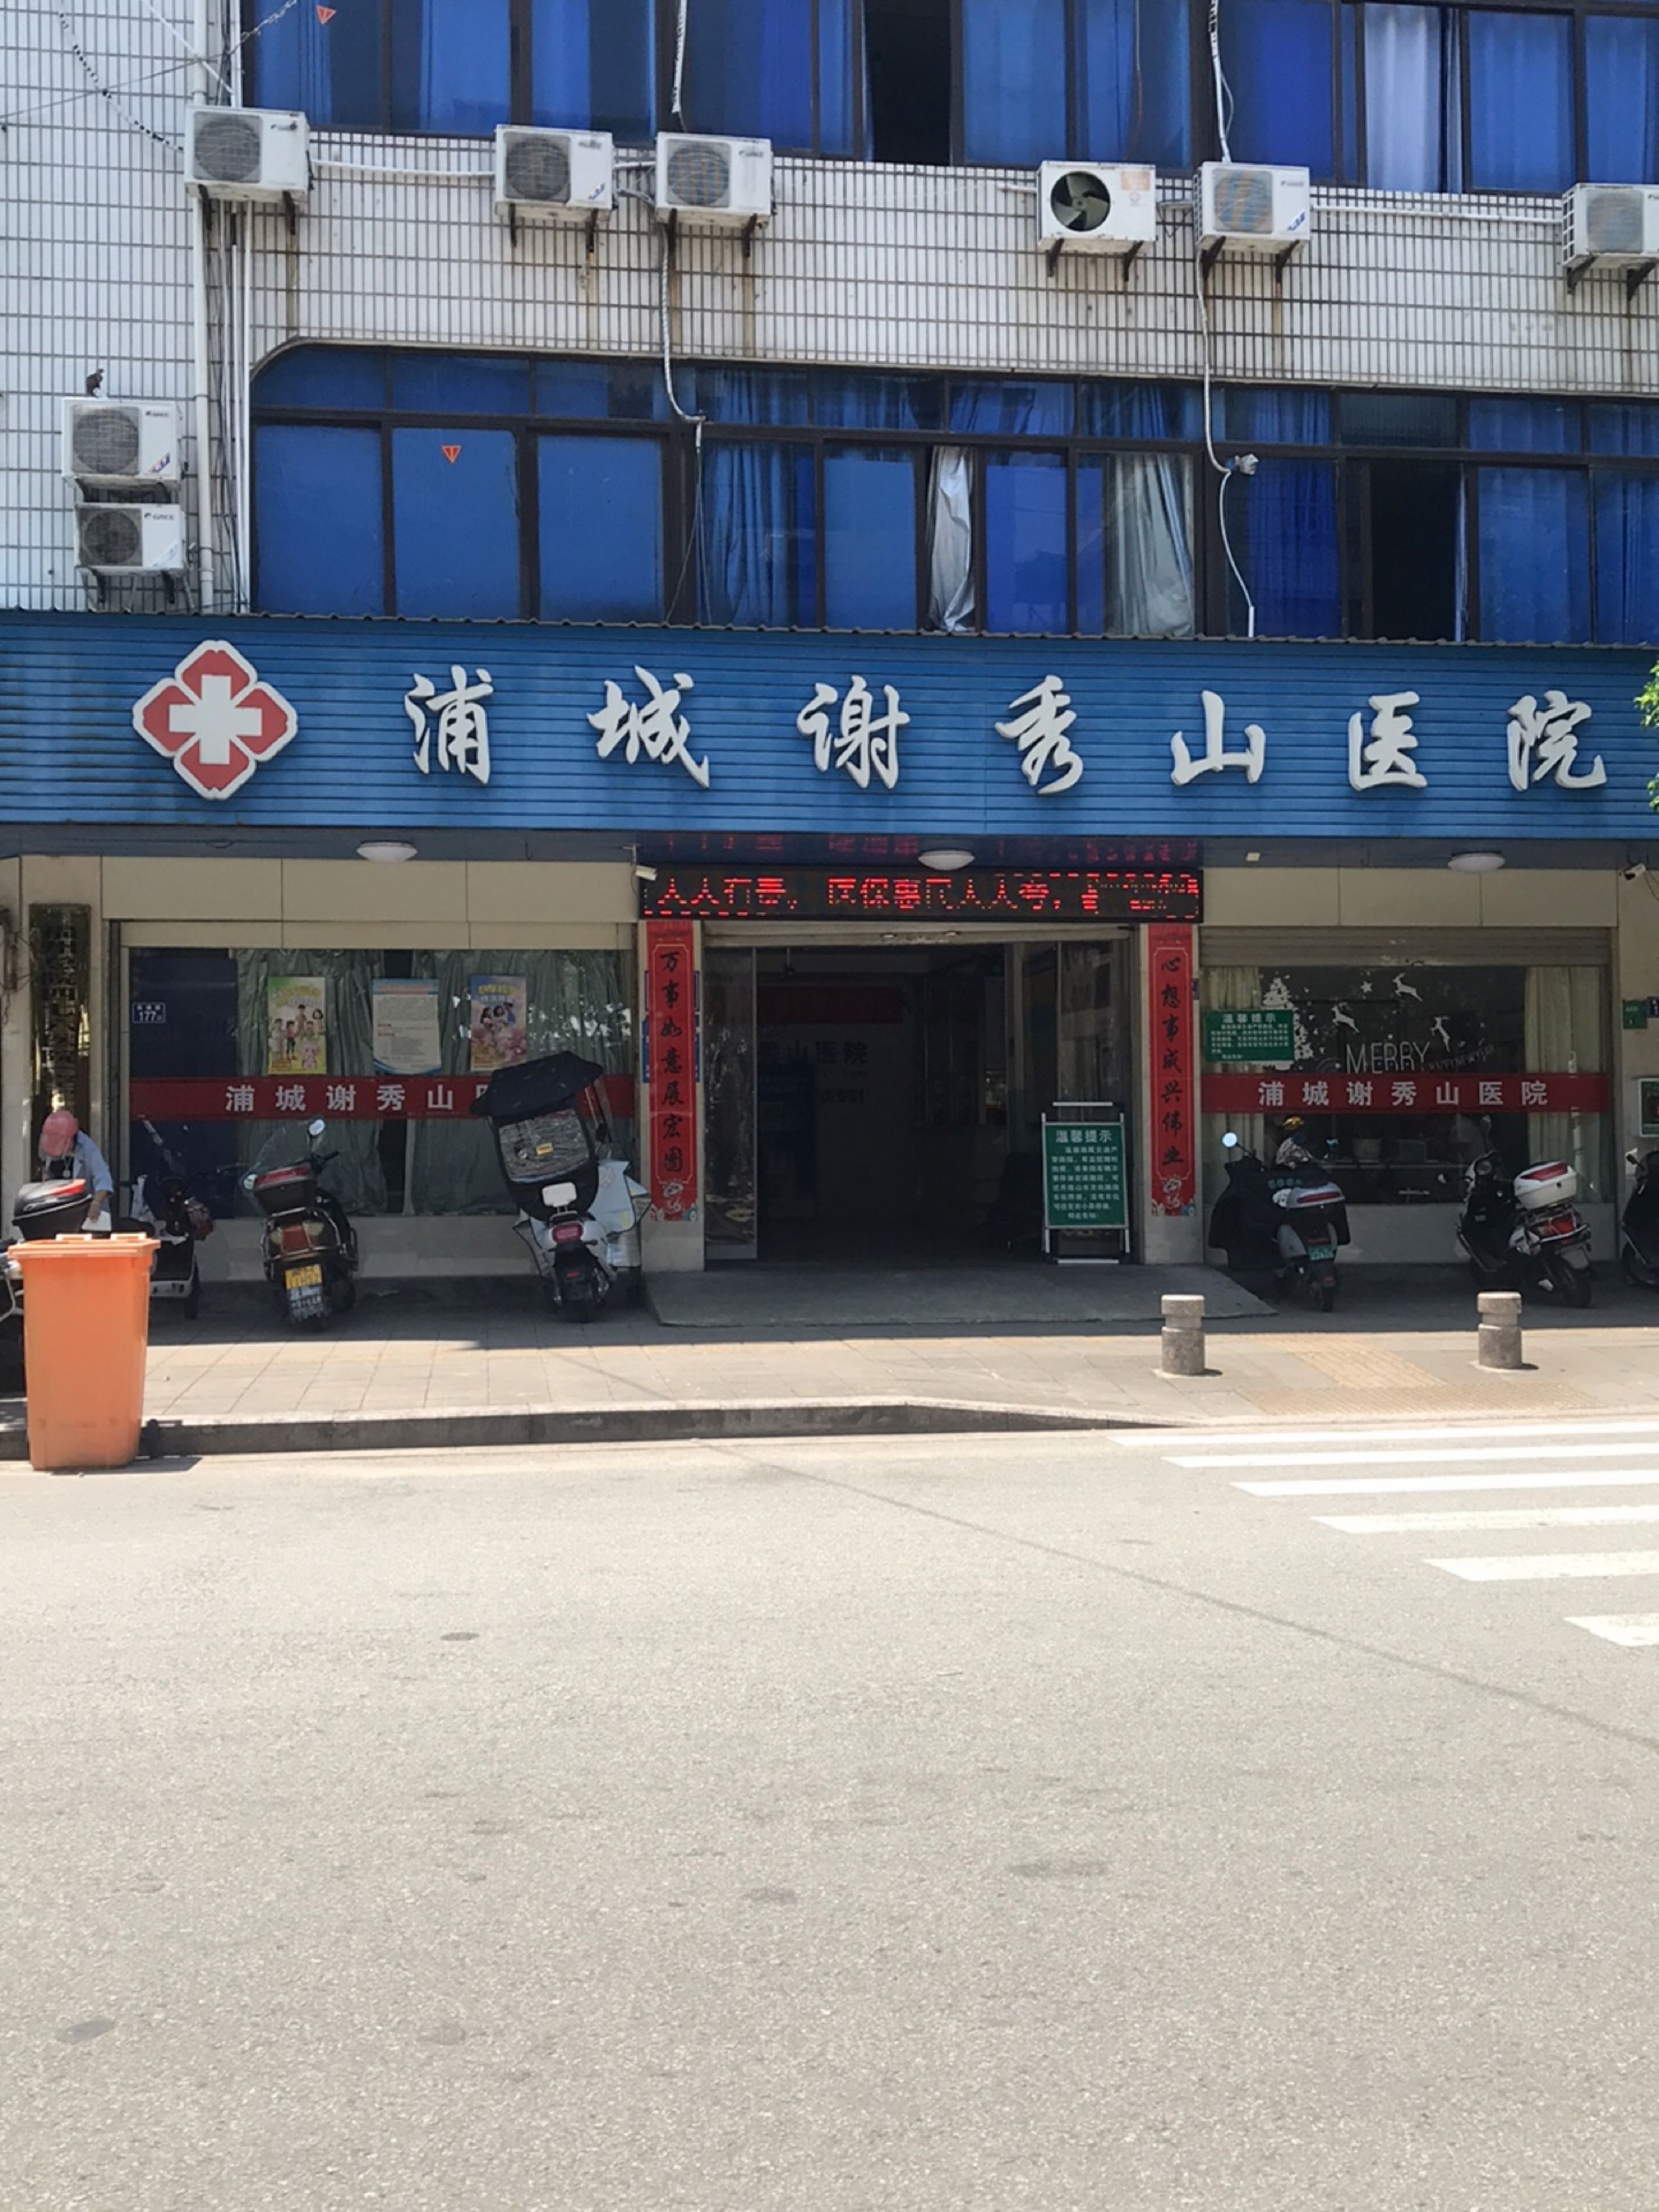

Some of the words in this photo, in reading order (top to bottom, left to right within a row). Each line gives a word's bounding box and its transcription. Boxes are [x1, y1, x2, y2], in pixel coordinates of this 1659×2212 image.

[404, 664, 1608, 794] 浦城谢秀山医院
[1160, 956, 1184, 1166] 心想事成兴伟业
[1345, 1041, 1431, 1074] MERRY
[225, 1084, 494, 1112] 浦城谢秀山
[1257, 1080, 1549, 1107] 浦城谢秀山医院
[1055, 1129, 1112, 1144] 温馨提示
